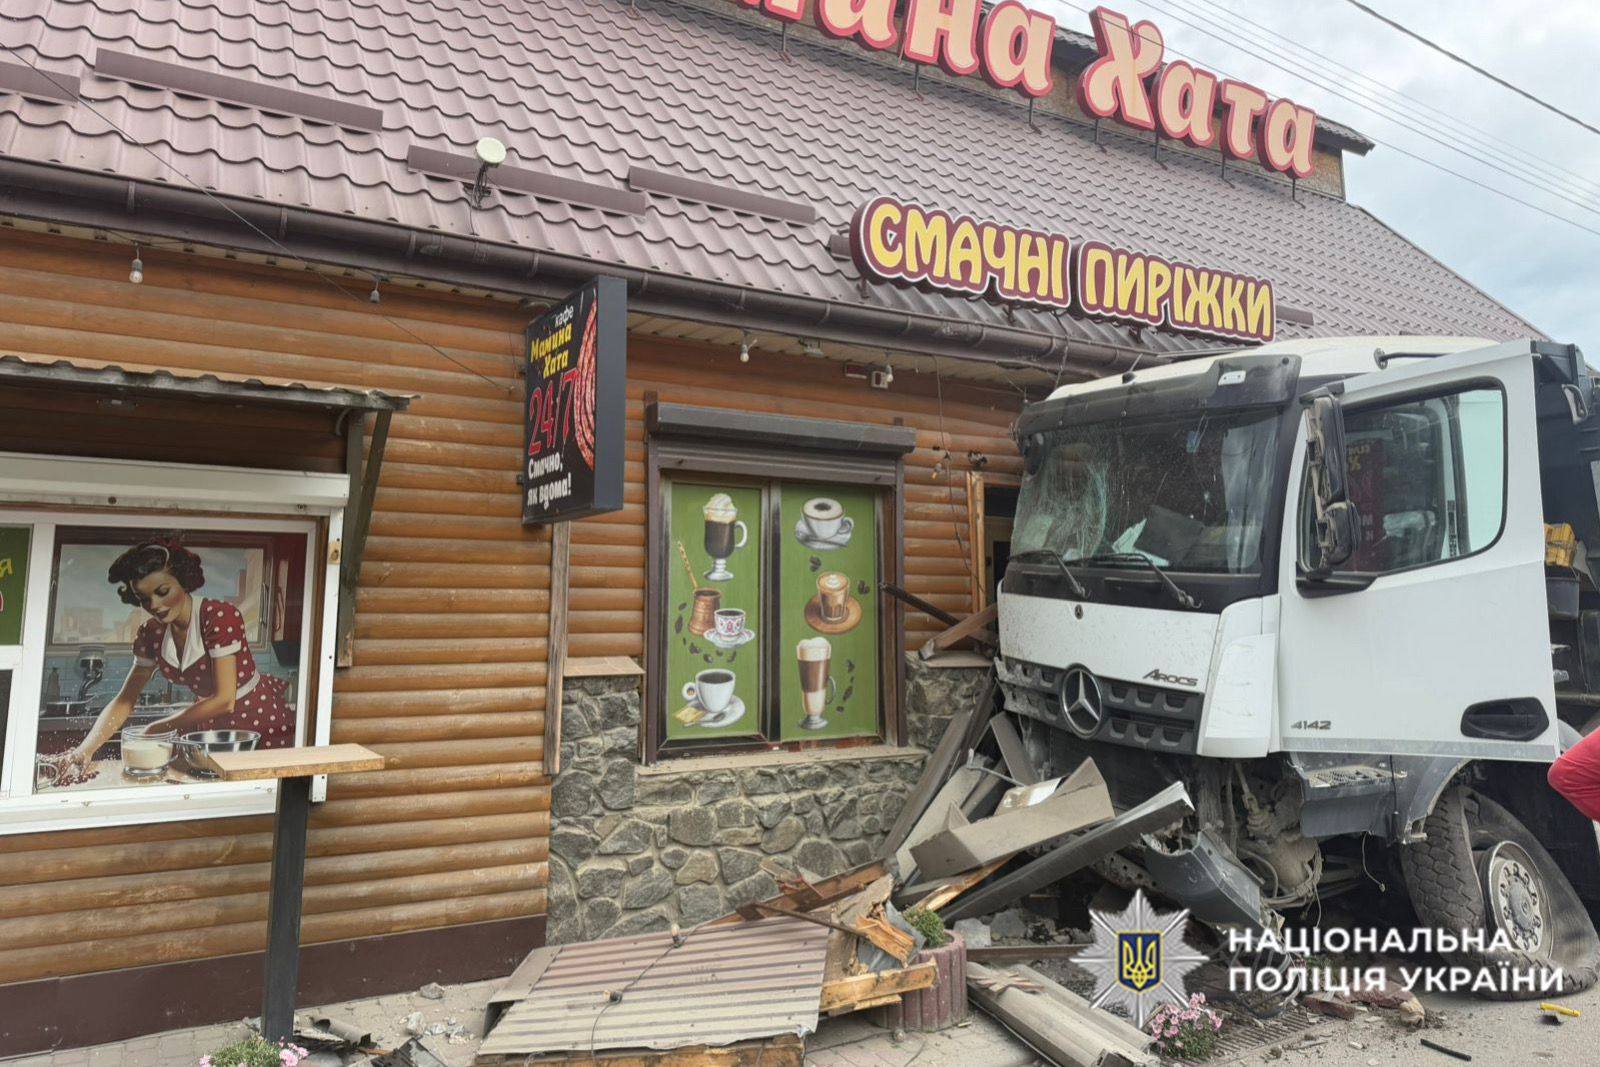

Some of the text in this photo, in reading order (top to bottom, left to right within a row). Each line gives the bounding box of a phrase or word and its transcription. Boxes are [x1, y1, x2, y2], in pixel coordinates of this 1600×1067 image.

[738, 0, 1316, 178] ина Хата
[868, 202, 1271, 340] СМАЧНІ ПИРІЖКИ
[555, 305, 574, 328] кафе
[531, 323, 572, 364] Мамина
[543, 350, 568, 379] Хата
[528, 367, 579, 457] 24/7
[528, 452, 563, 480] Смачно,
[527, 472, 571, 510] як вдома!
[1291, 720, 1332, 730] 4142
